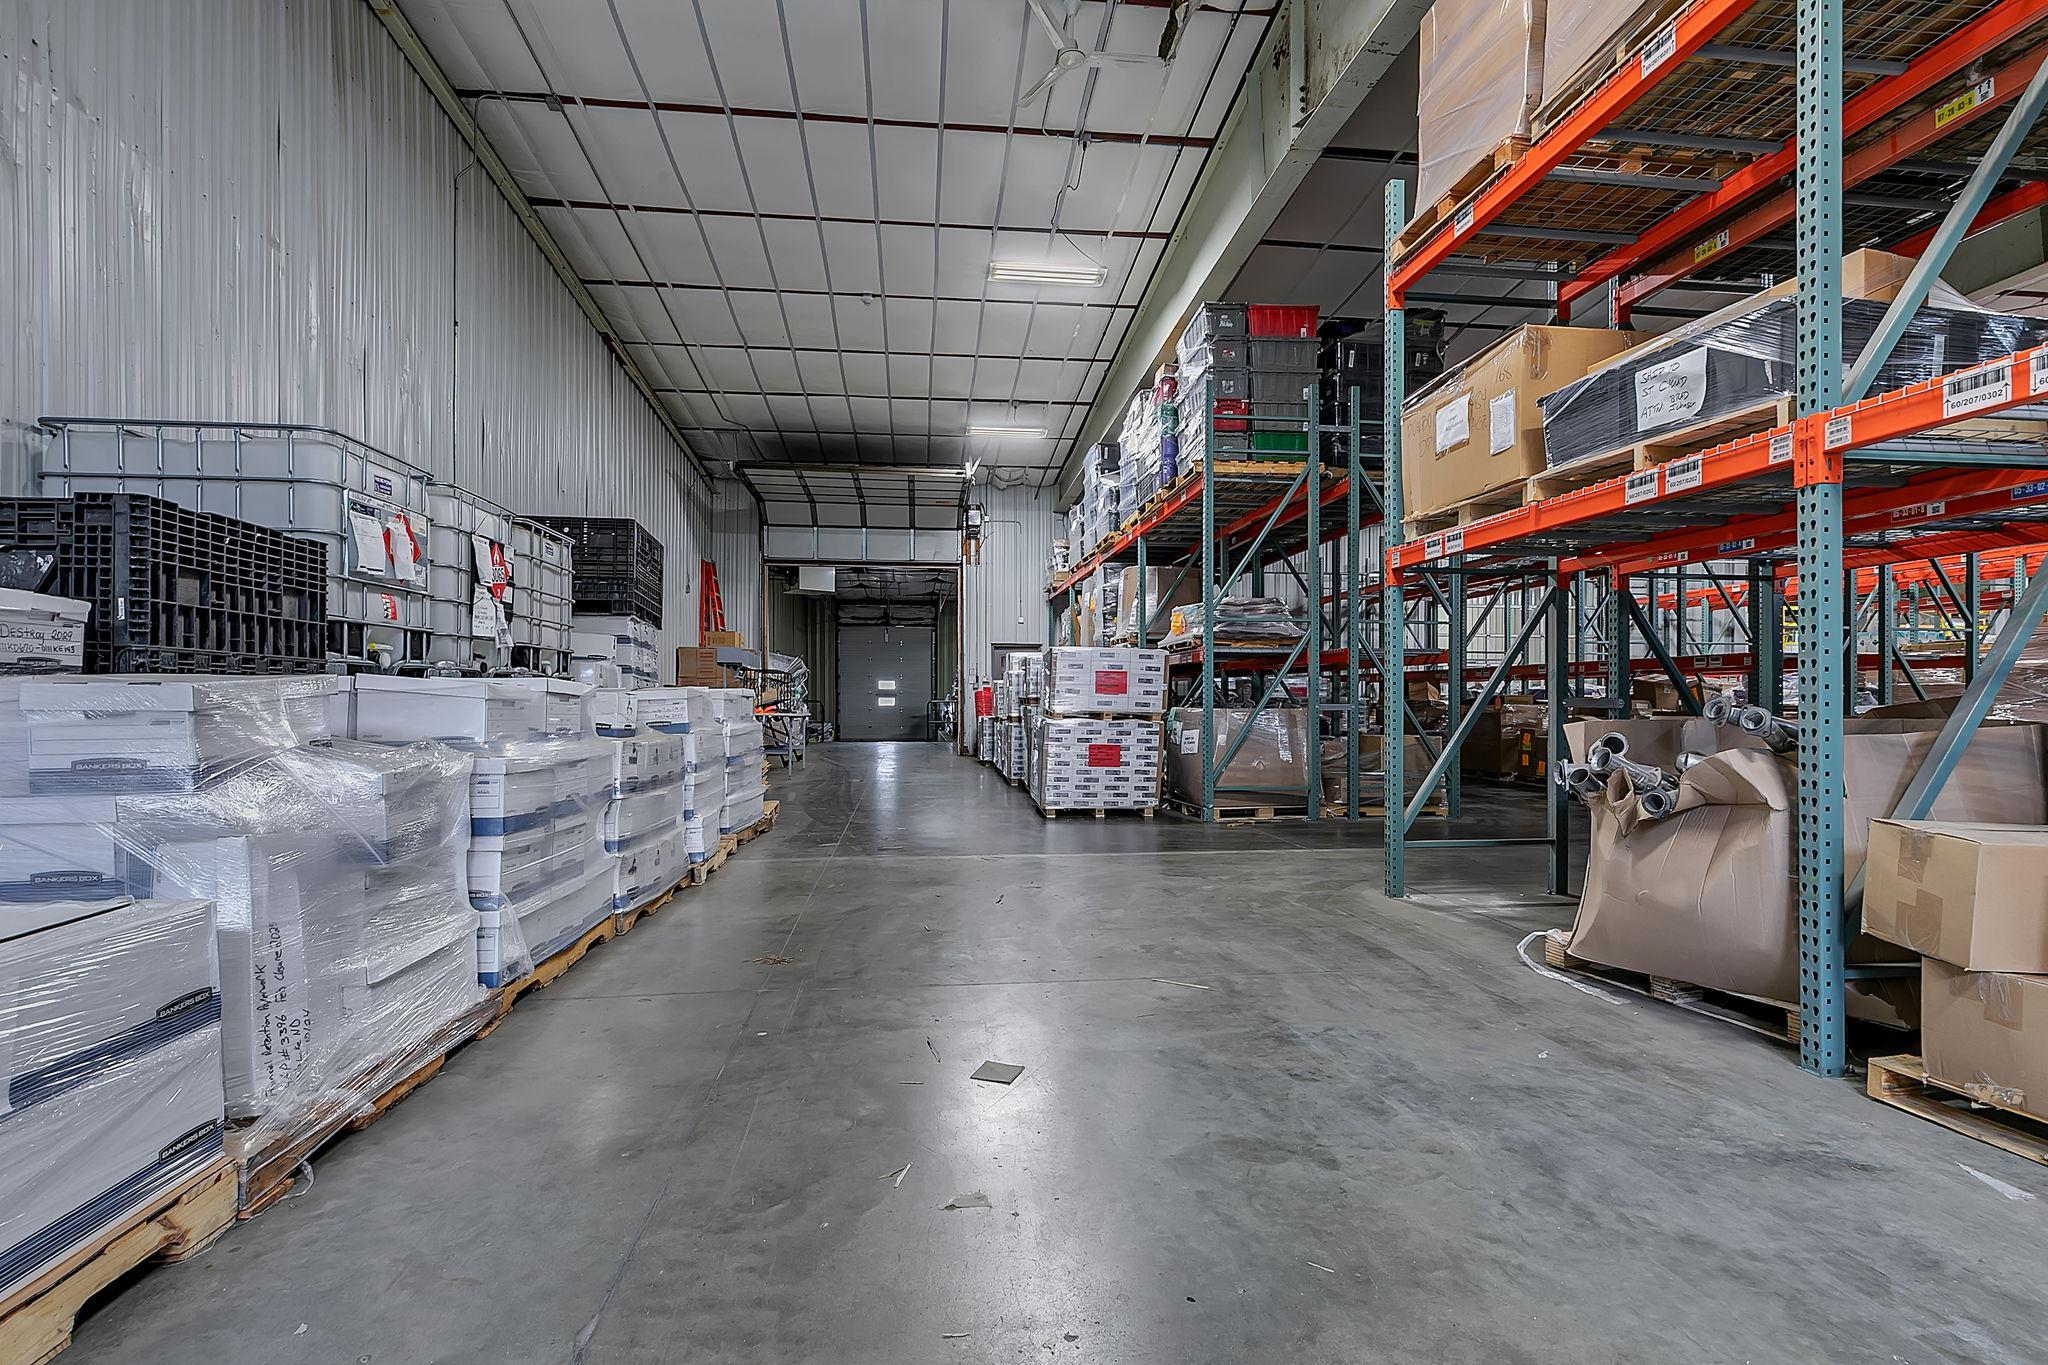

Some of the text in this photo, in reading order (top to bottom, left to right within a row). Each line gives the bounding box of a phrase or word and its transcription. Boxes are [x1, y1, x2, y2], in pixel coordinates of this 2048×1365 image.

[1950, 389, 2003, 410] 60/207/0302
[160, 991, 211, 1018] BANKERS BOX
[289, 1018, 301, 1036] ND
[162, 1123, 215, 1159] BANKERS BOX
